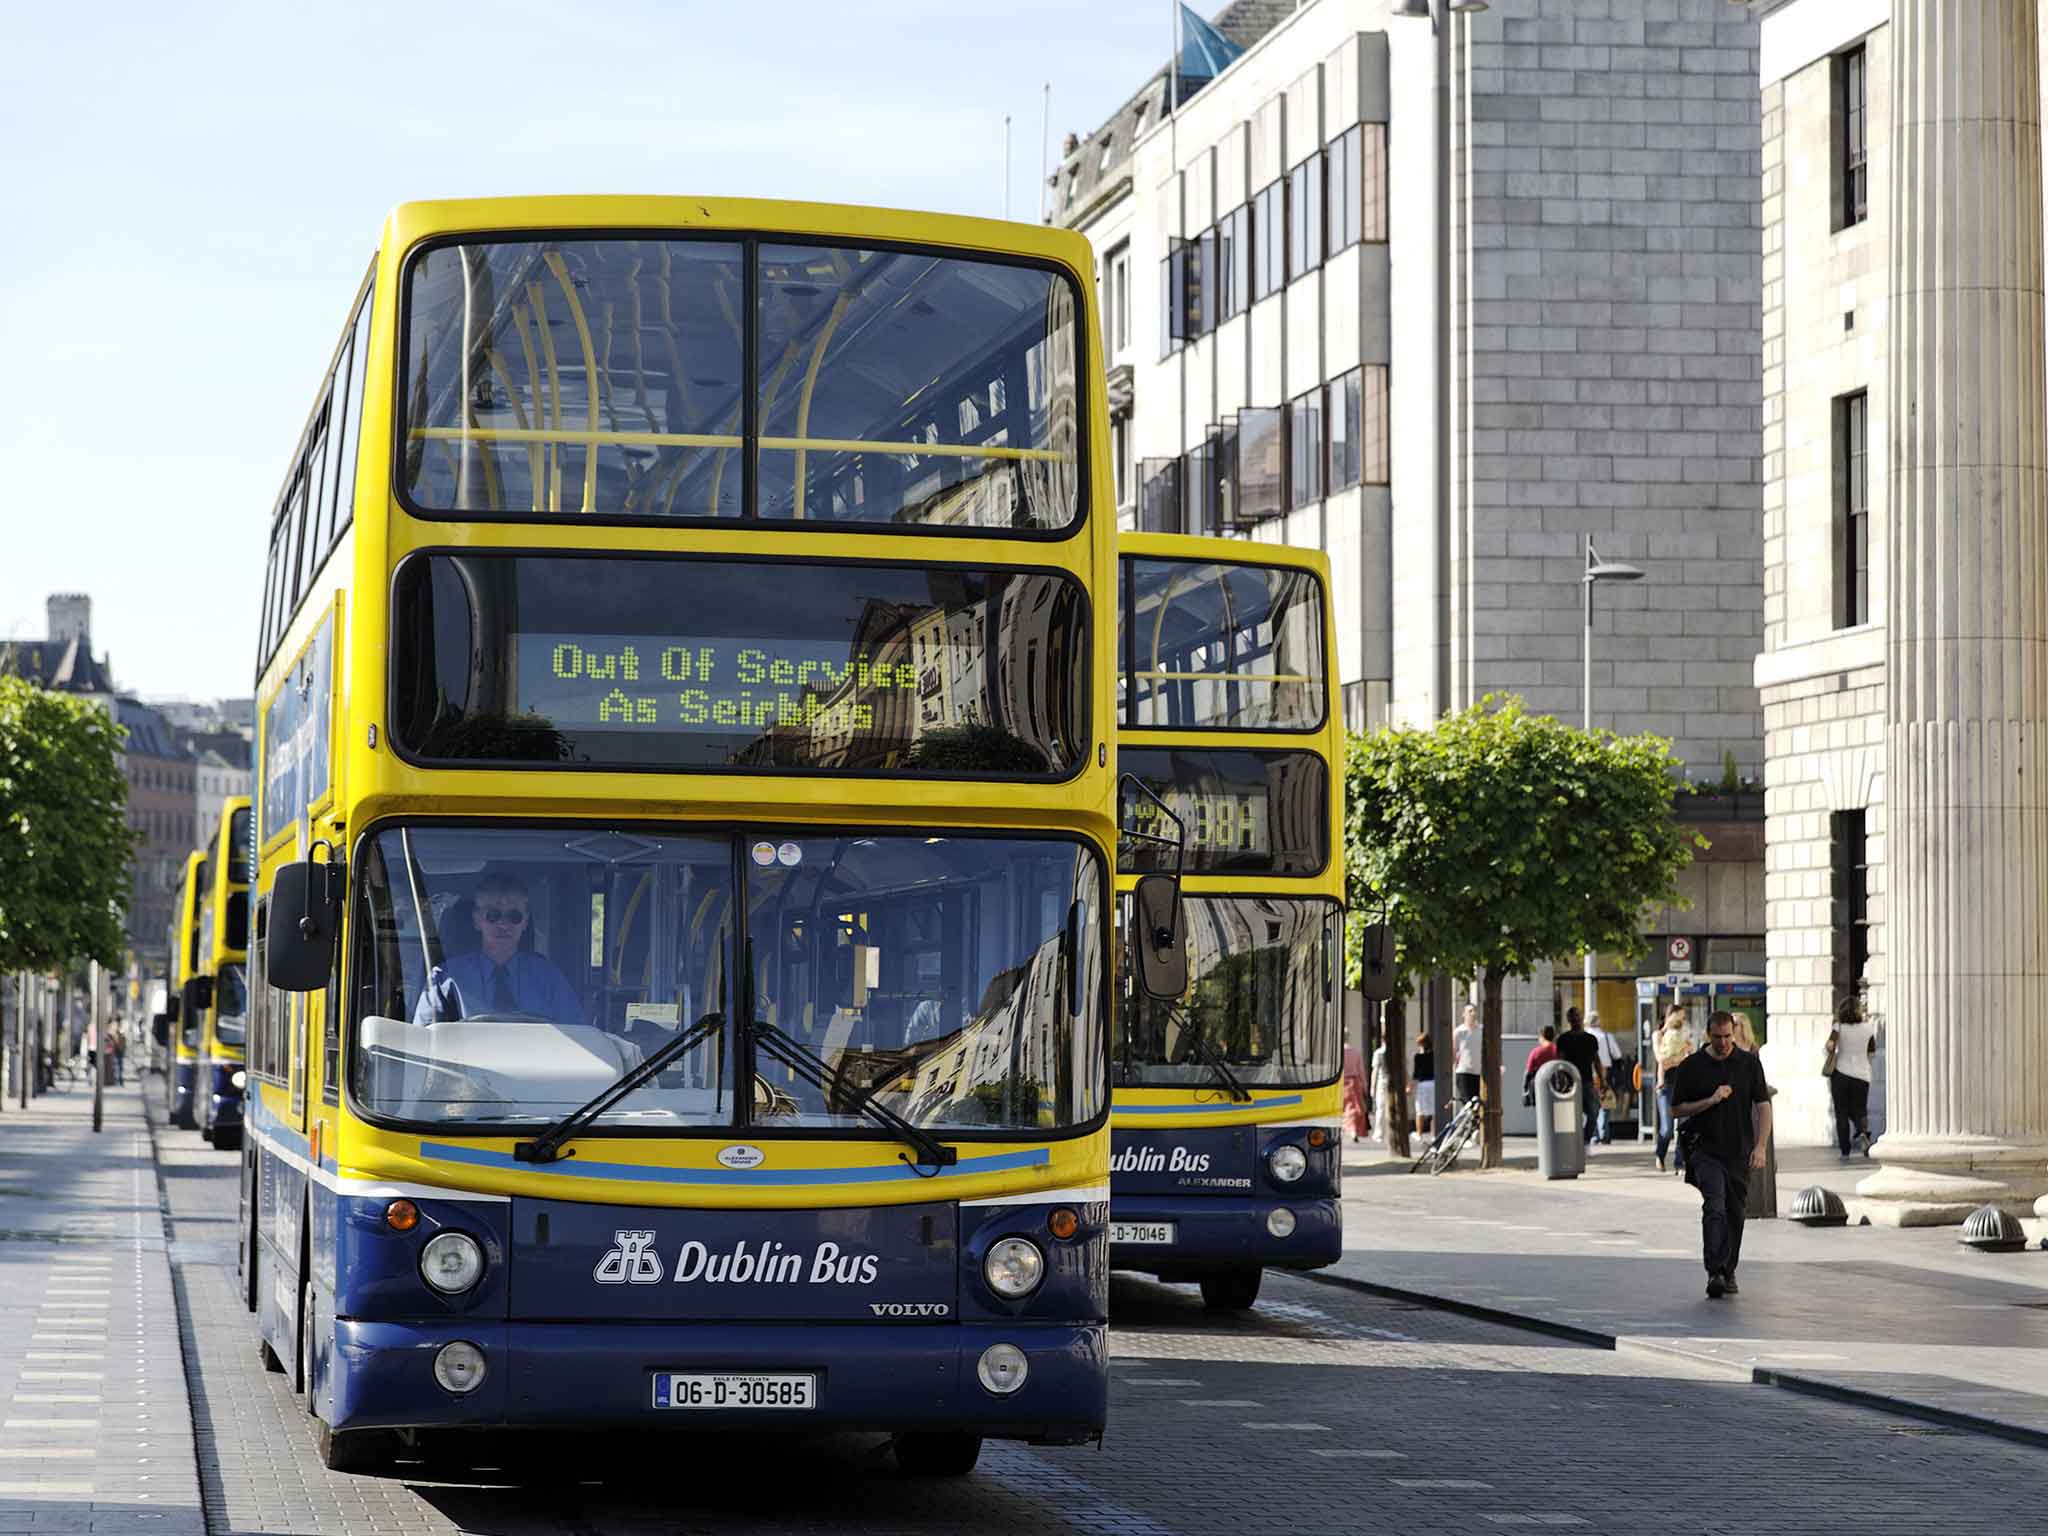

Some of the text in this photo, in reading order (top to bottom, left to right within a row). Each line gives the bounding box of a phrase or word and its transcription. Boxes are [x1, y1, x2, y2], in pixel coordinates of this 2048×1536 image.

[552, 644, 919, 689] Out Of Service
[599, 687, 657, 724] As
[1110, 1146, 1210, 1172] ublin Bus
[1177, 1177, 1252, 1188] ALEXANDER
[1111, 1226, 1166, 1241] -D-70146
[673, 1240, 880, 1285] Dublin Bus
[869, 1303, 950, 1316] VOLVO
[675, 1381, 806, 1404] 06-D-30585
